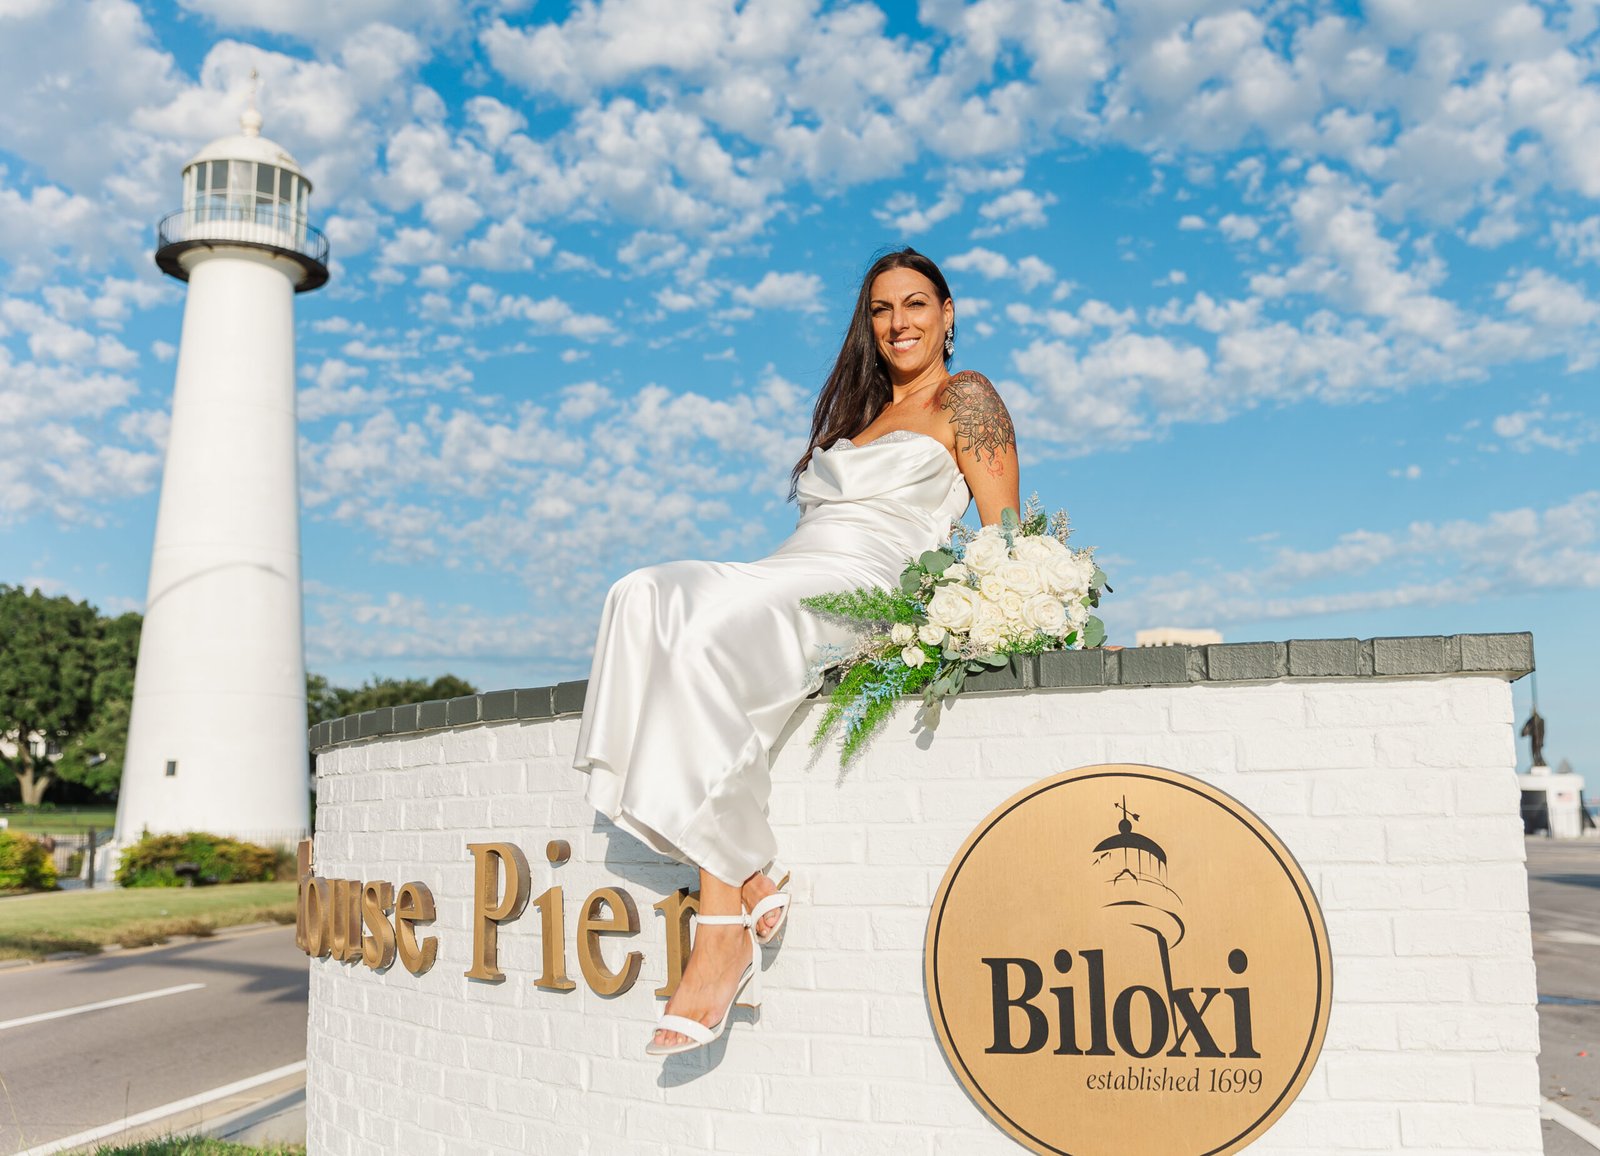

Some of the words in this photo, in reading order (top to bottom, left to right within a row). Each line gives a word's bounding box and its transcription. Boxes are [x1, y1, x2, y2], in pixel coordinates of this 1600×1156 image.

[981, 948, 1261, 1059] Biloxi
[1086, 1066, 1200, 1092] established
[1208, 1067, 1263, 1094] 1699
